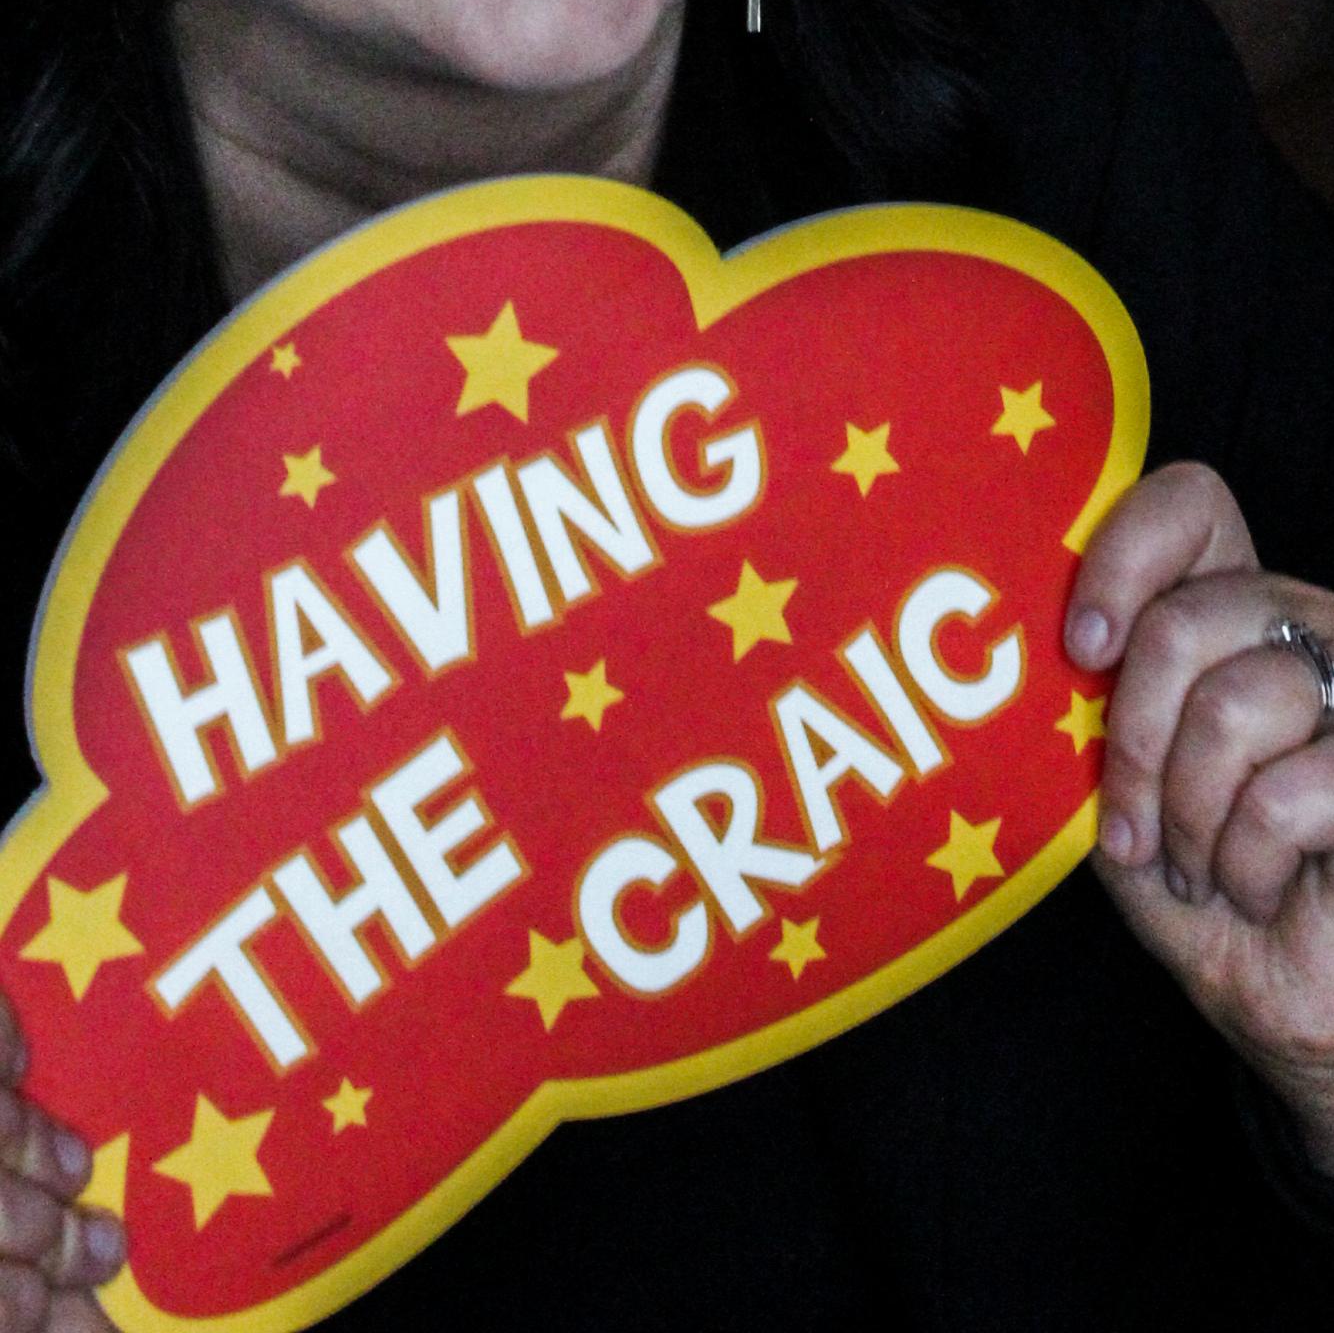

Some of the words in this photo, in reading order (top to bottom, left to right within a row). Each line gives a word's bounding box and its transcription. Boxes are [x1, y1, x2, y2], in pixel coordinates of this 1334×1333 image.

[122, 365, 765, 809] HAVING
[150, 729, 530, 1071] THE
[572, 569, 1025, 995] CRAIC
